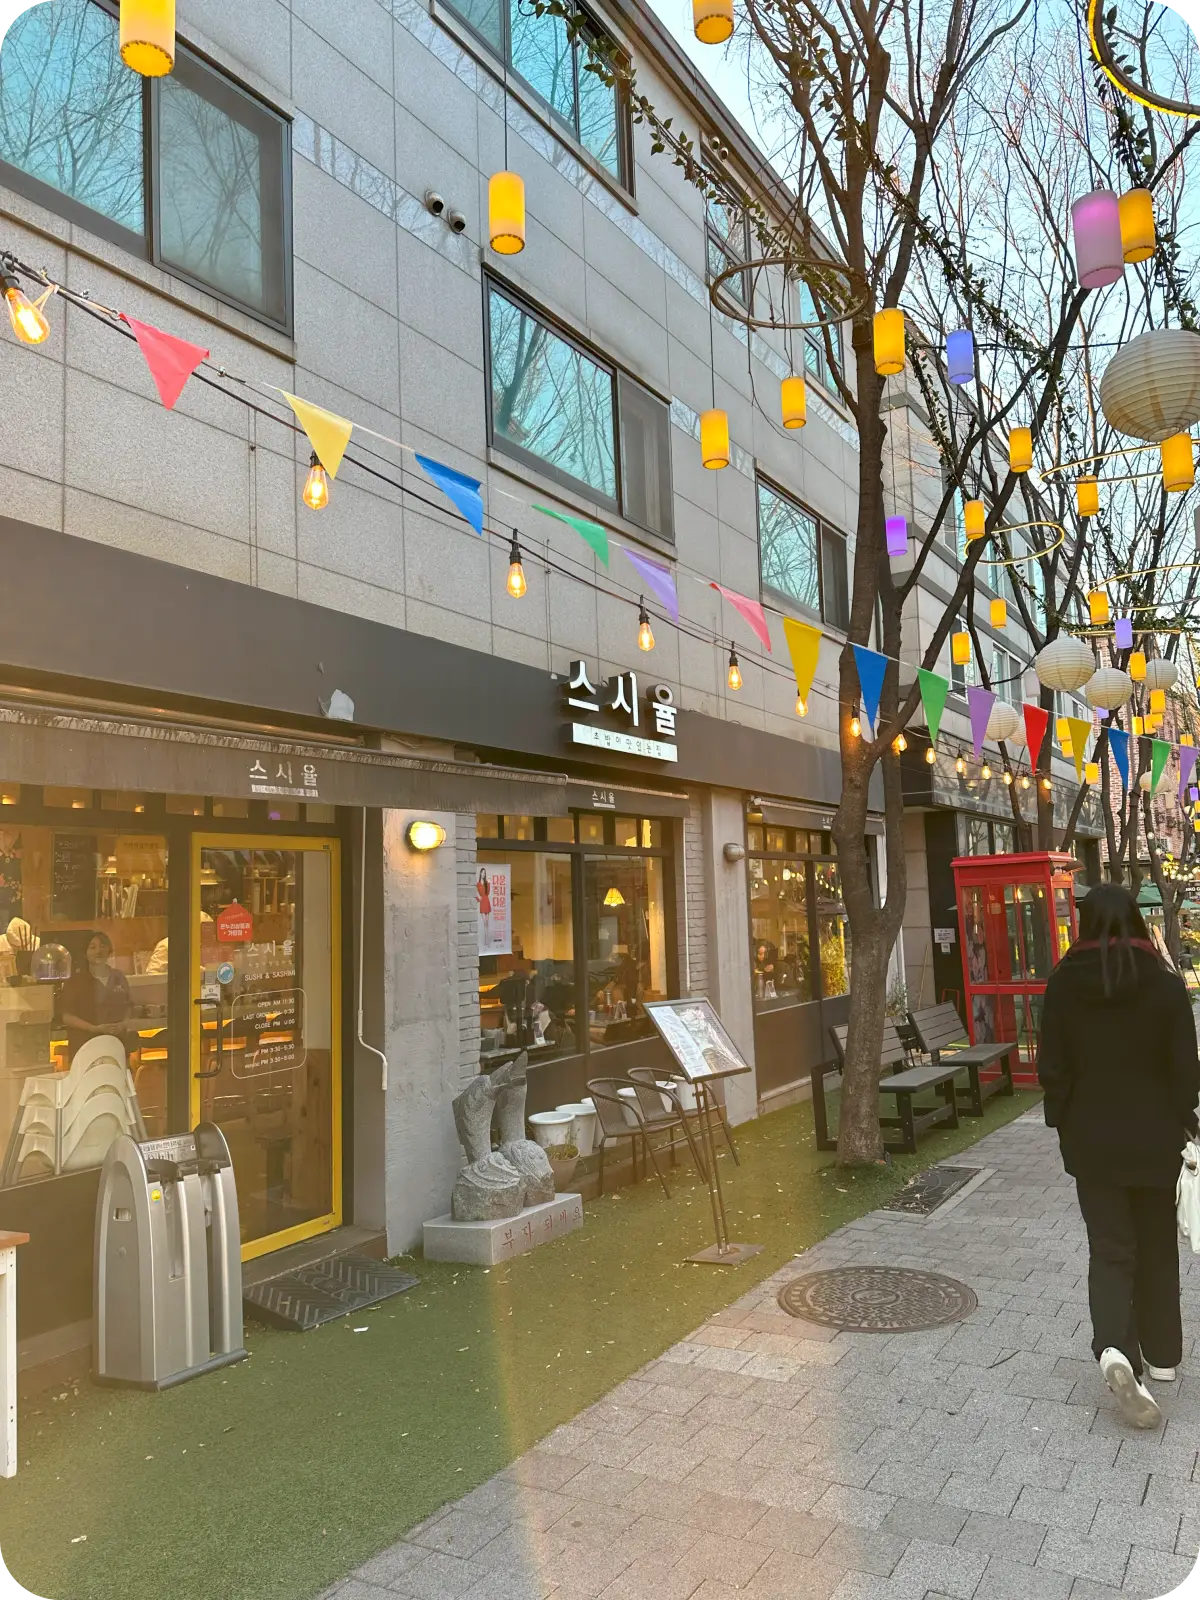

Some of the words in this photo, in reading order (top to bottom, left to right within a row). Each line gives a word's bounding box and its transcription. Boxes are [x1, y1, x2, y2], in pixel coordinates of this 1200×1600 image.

[569, 660, 677, 736] 스시율
[249, 759, 317, 786] 스시율
[592, 790, 615, 804] 스시율
[492, 874, 506, 885] 다운
[492, 896, 506, 907] 다운
[246, 940, 294, 957] 스시율
[244, 972, 263, 981] SUSHI
[257, 1000, 271, 1008] OPEN
[243, 1013, 254, 1021] LAST
[254, 1022, 271, 1030] CLOSE
[261, 1047, 269, 1055] PM
[261, 1058, 269, 1066] PM
